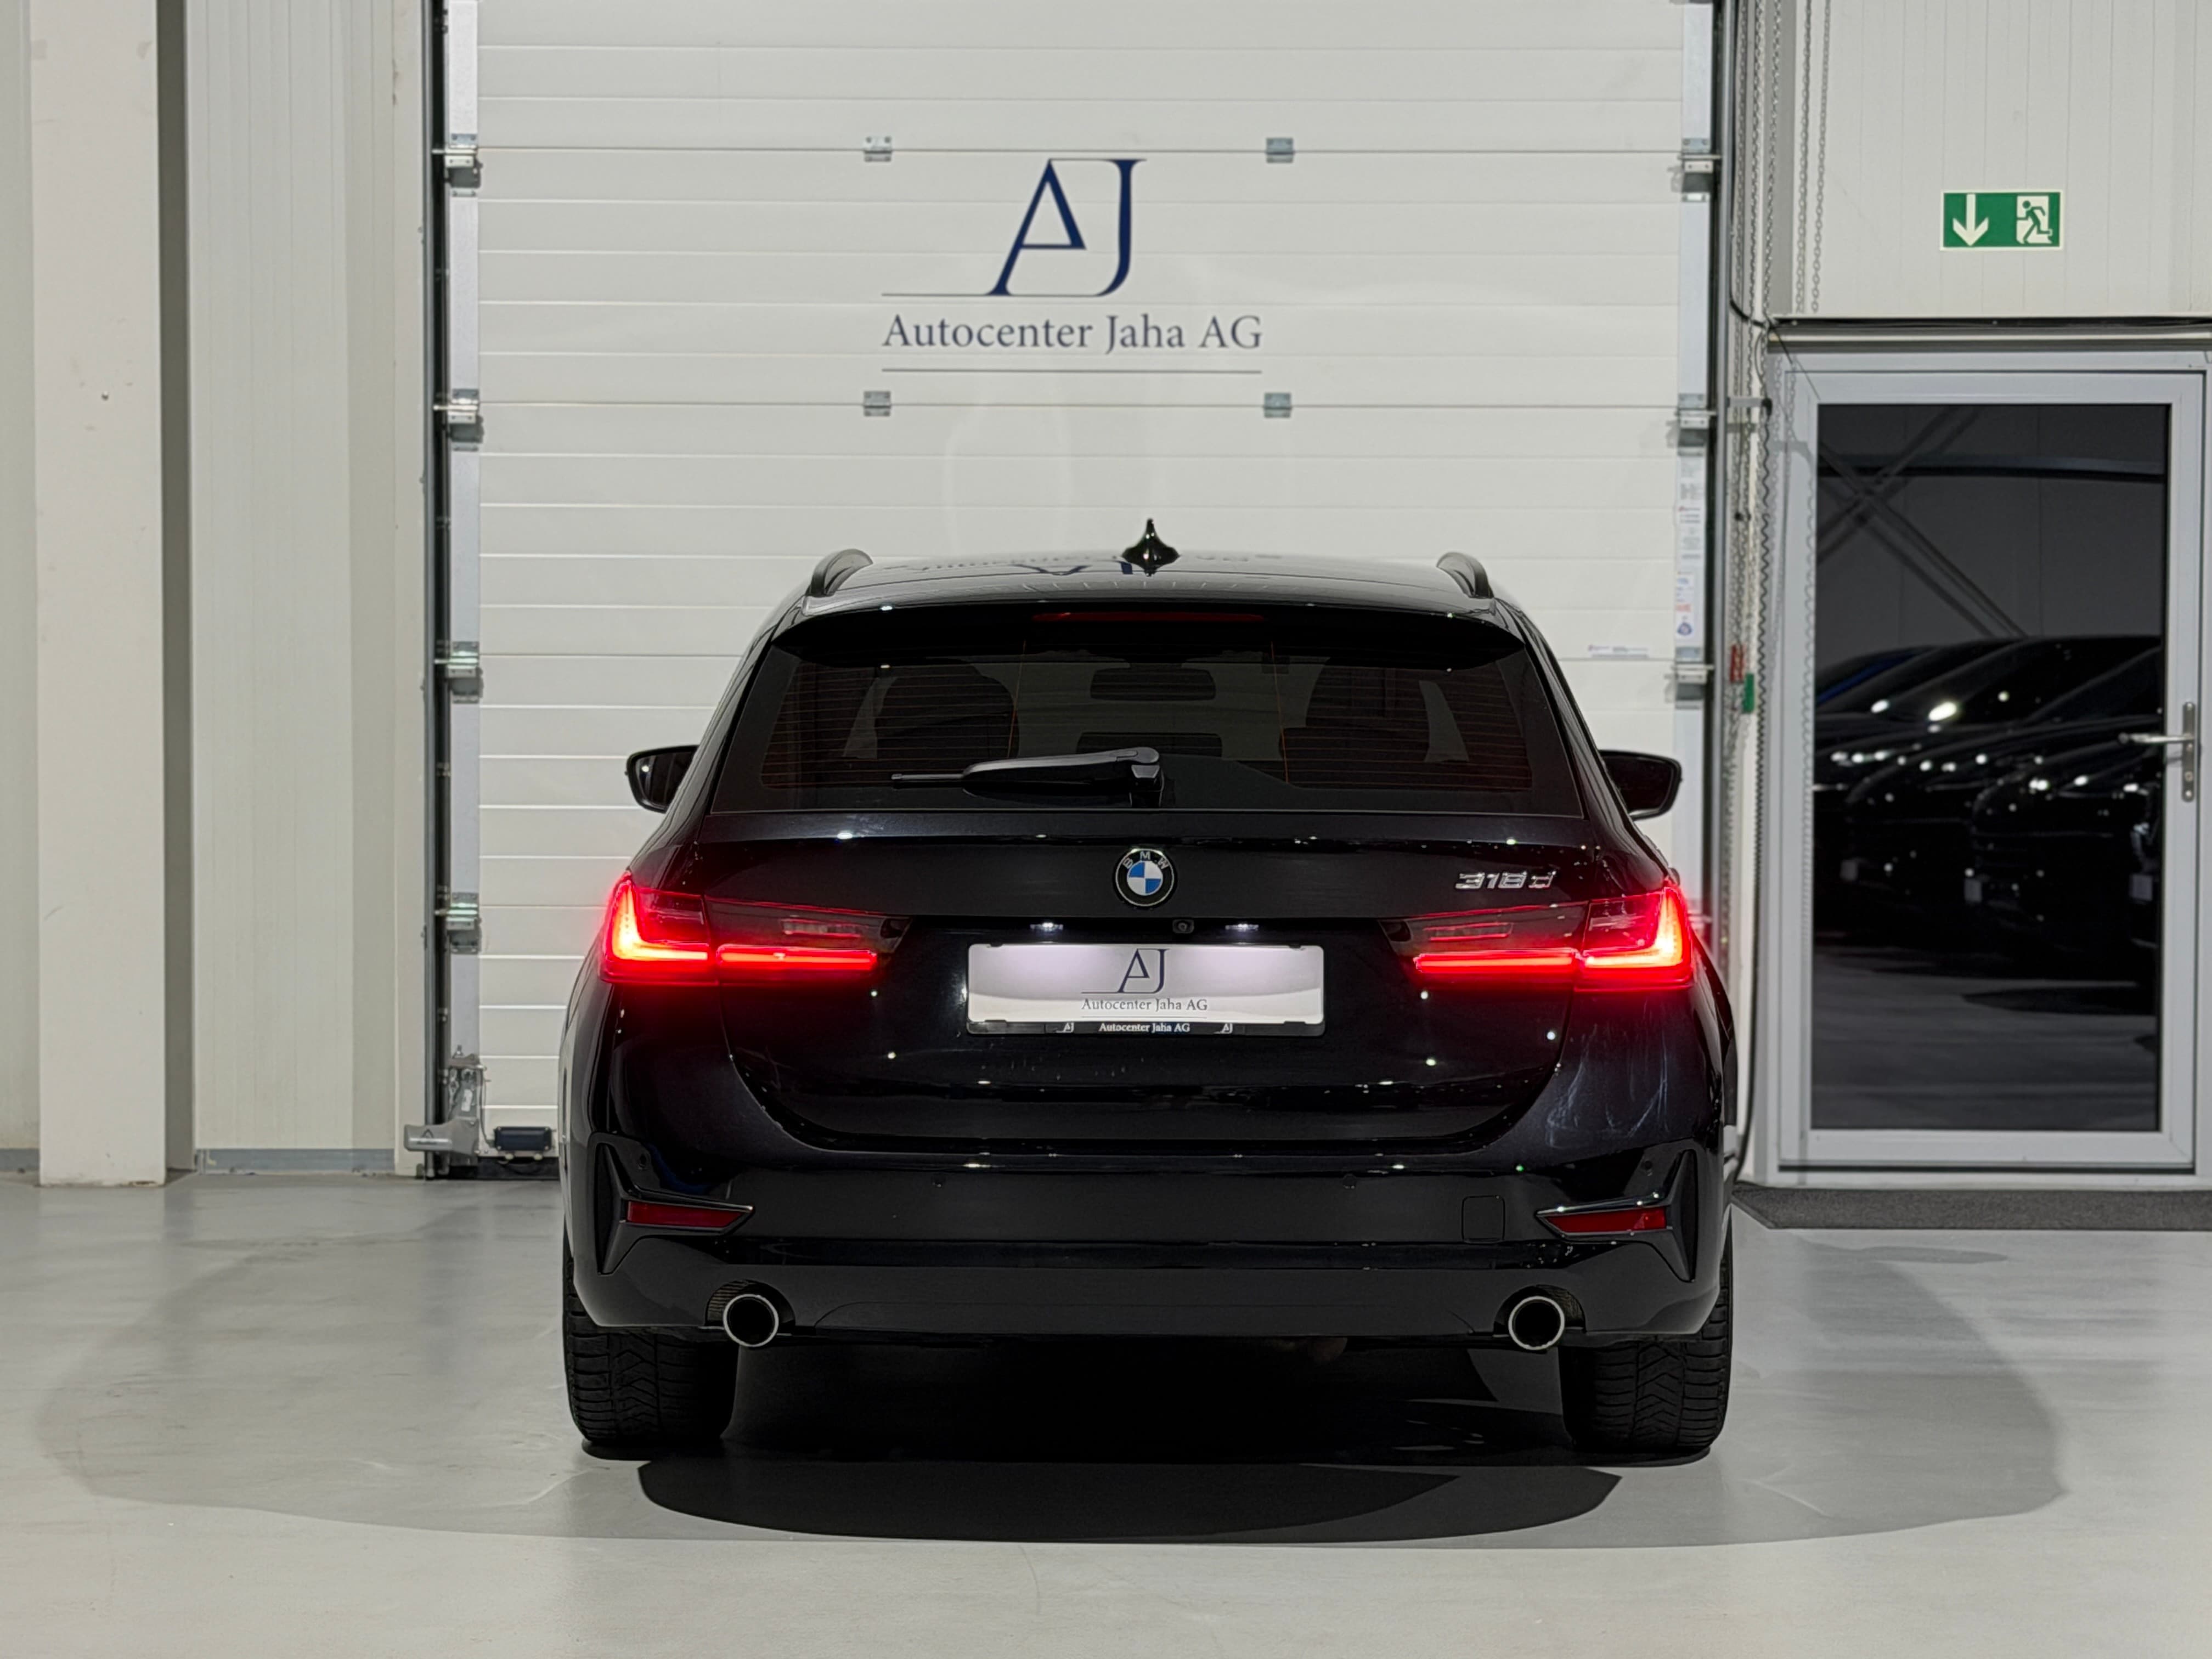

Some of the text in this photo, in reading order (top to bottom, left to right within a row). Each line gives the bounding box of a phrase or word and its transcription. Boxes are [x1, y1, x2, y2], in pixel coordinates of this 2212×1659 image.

[987, 158, 1147, 297] AJ
[881, 313, 1262, 355] Autocenter Jaha AG
[1122, 850, 1170, 870] BMW
[1455, 871, 1557, 889] 318d
[1117, 948, 1170, 994] AJ
[1081, 997, 1207, 1012] Autocenter Jaha AG
[1098, 1022, 1190, 1033] Autocenter Jaha AG
